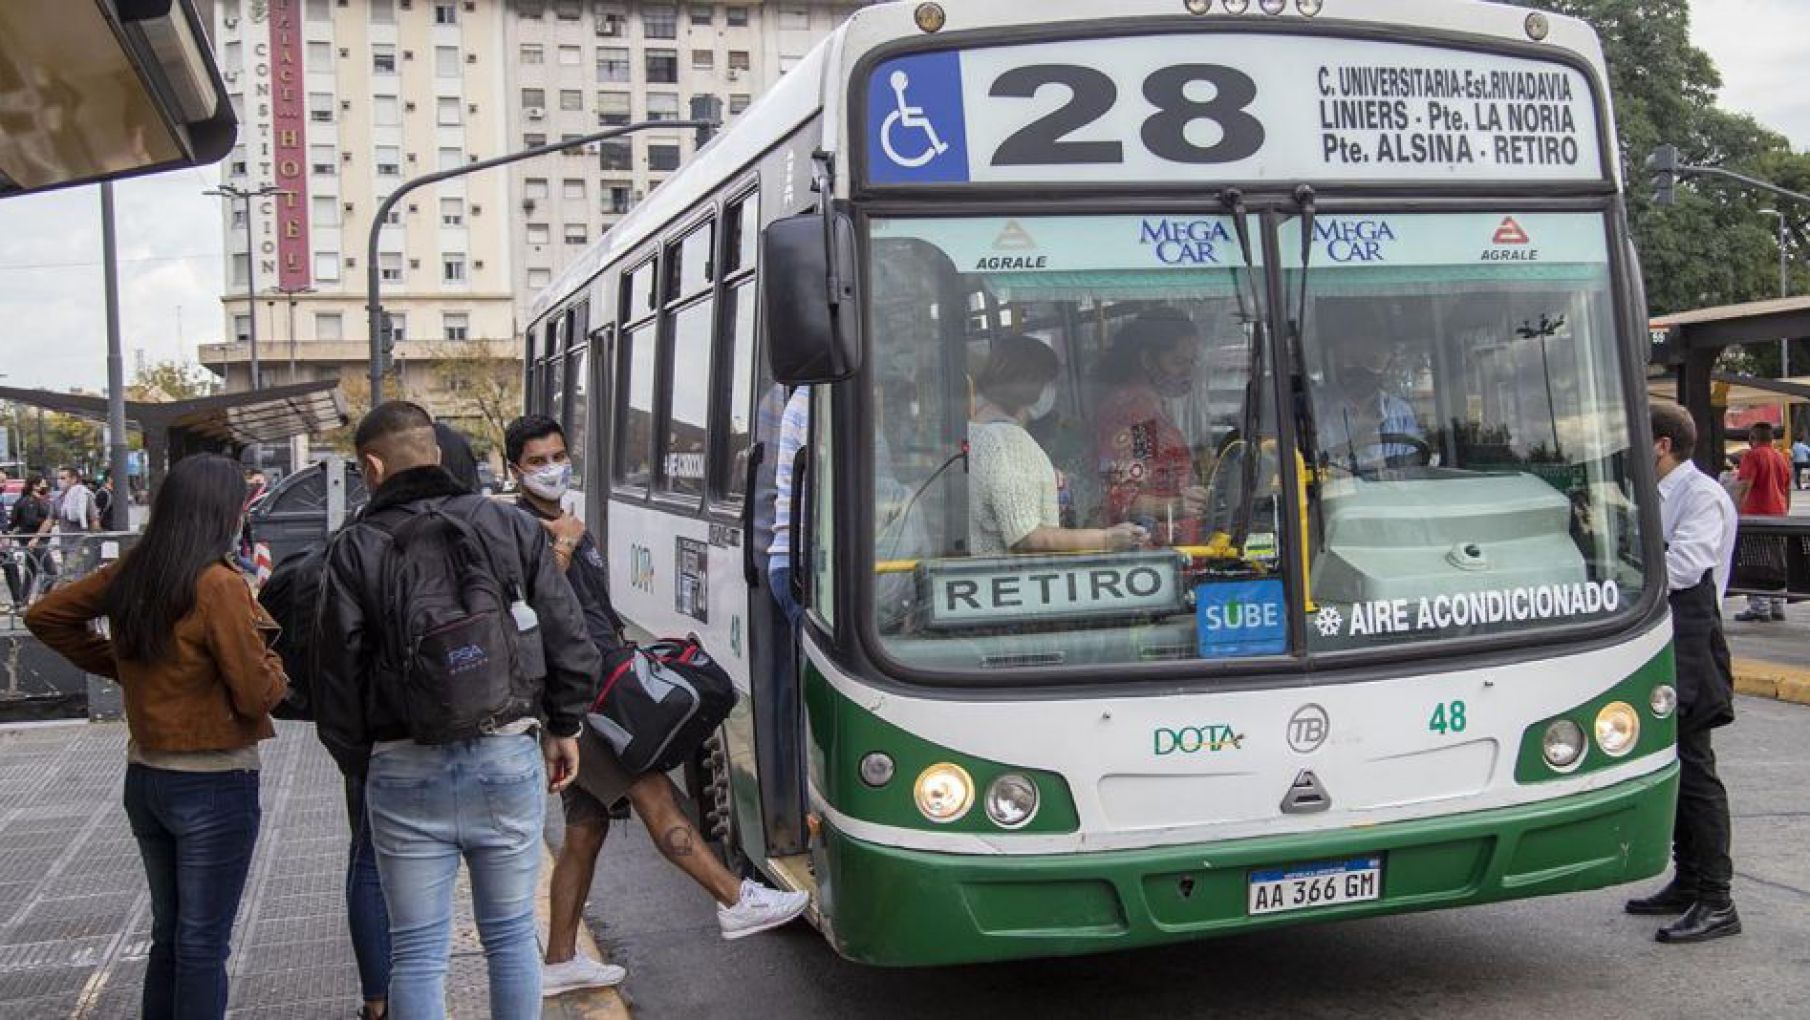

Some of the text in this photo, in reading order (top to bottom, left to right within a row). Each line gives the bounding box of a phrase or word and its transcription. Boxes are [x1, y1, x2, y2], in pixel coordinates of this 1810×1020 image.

[1318, 65, 1335, 97] C.
[988, 63, 1265, 166] 28
[1319, 100, 1409, 130] LINIERS
[1427, 102, 1469, 131] Pte.
[1475, 102, 1502, 132] LA
[1508, 103, 1576, 134] NORIA
[1322, 133, 1369, 163] Pte.
[1377, 133, 1474, 163] ALSINA
[1494, 135, 1578, 165] RETIRO
[280, 129, 302, 273] HOTEL
[1140, 218, 1232, 244] MEGA
[1312, 218, 1396, 242] MEGA
[976, 255, 1047, 270] AGRALE
[1155, 240, 1219, 265] CAR
[1327, 238, 1385, 262] CAR
[1480, 249, 1538, 261] AGRALE
[946, 567, 1162, 611] RETIRO
[1206, 603, 1278, 630] SUBE
[1349, 579, 1620, 636] AIRE ACONDICIONADO
[1291, 718, 1324, 743] TB
[1428, 700, 1467, 735] 48
[1154, 724, 1241, 756] DOTA
[1255, 884, 1283, 910] AA
[1293, 876, 1337, 905] 366
[1345, 872, 1375, 897] GM
